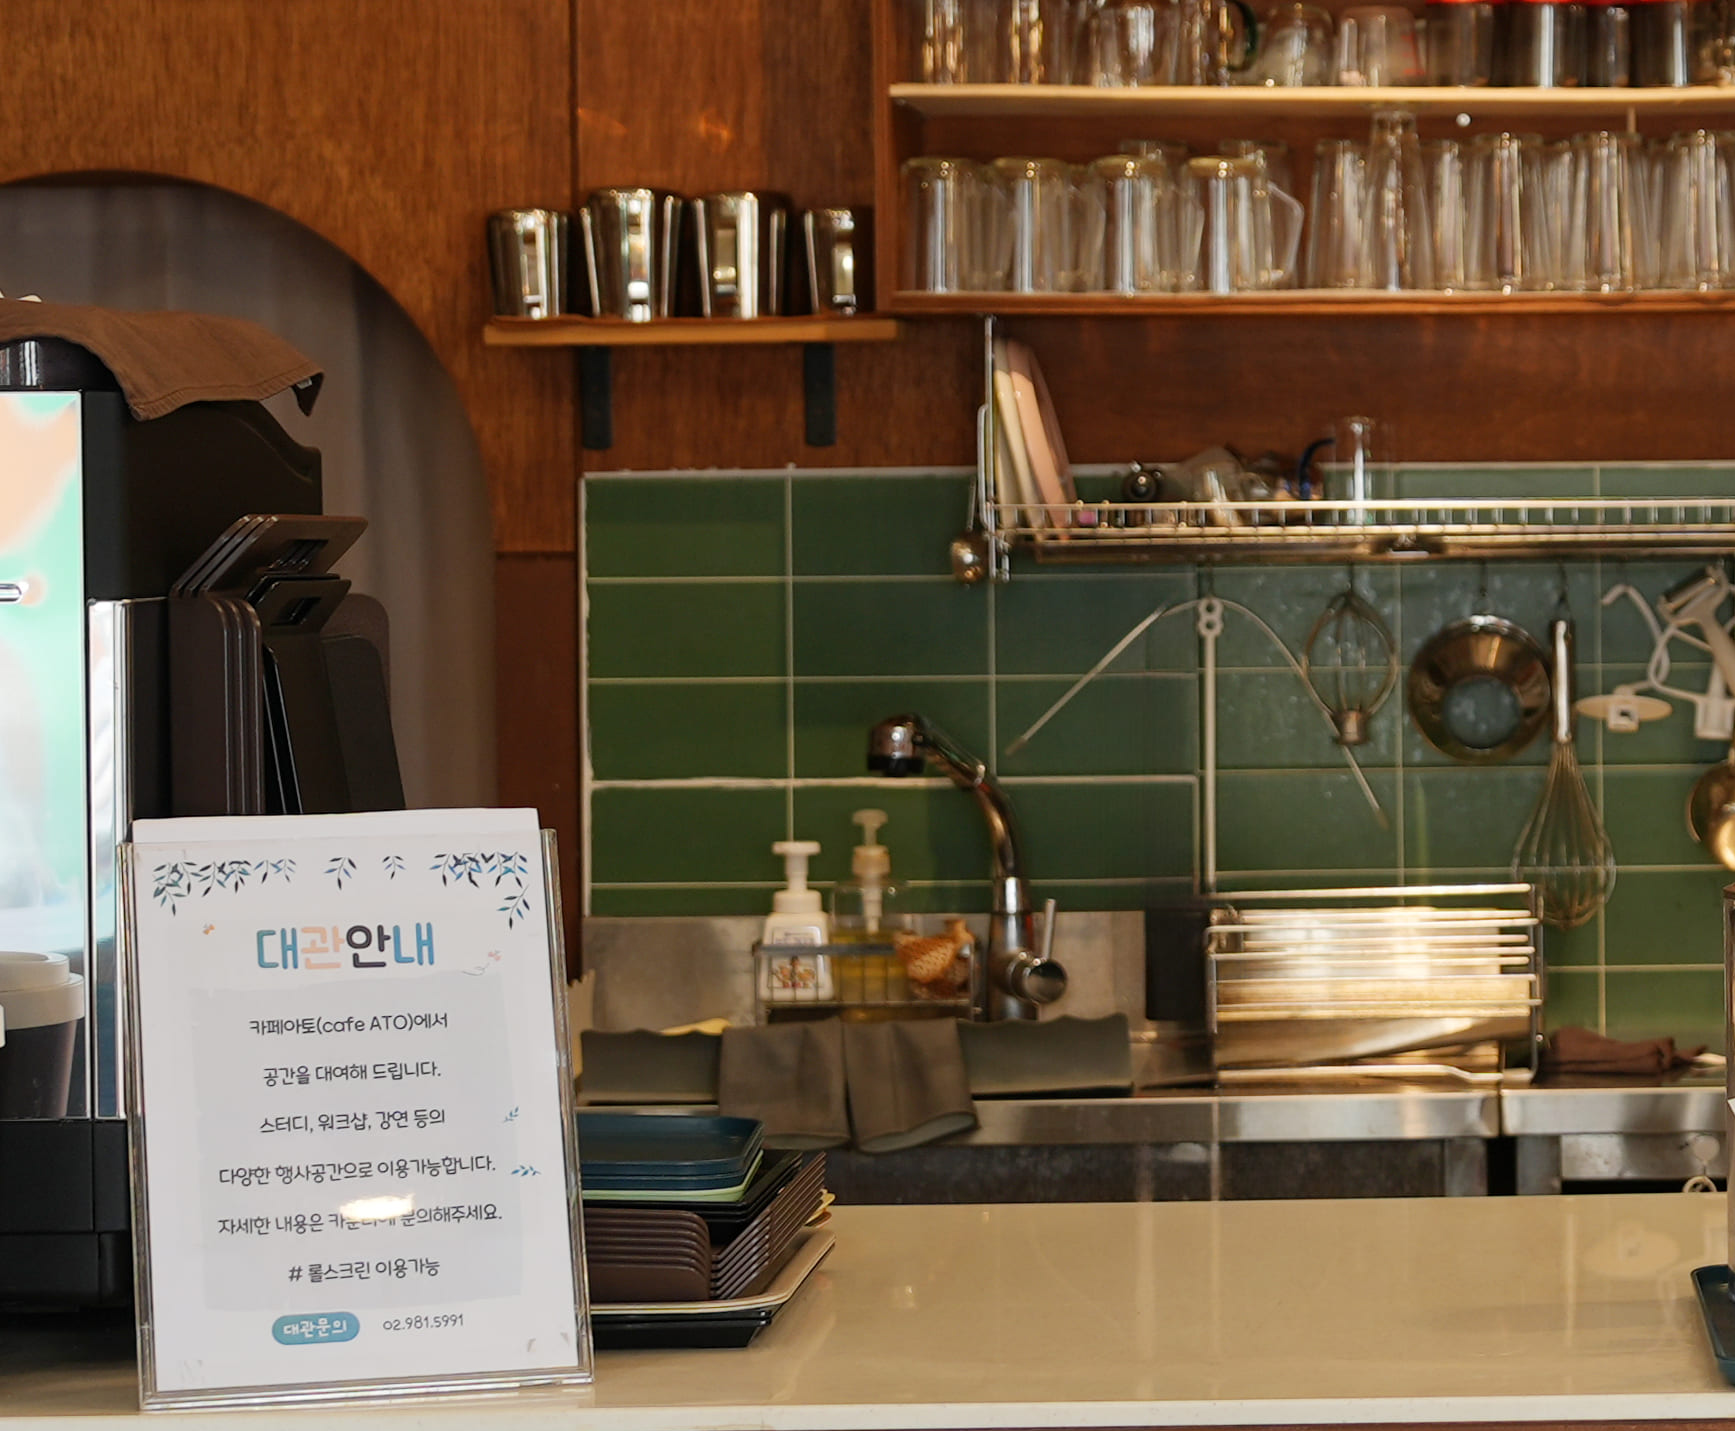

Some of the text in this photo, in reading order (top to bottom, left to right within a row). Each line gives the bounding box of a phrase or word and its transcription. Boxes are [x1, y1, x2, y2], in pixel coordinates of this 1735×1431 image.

[256, 922, 435, 971] 대관안내
[283, 1313, 464, 1337] 대관문의 02.981.5991
